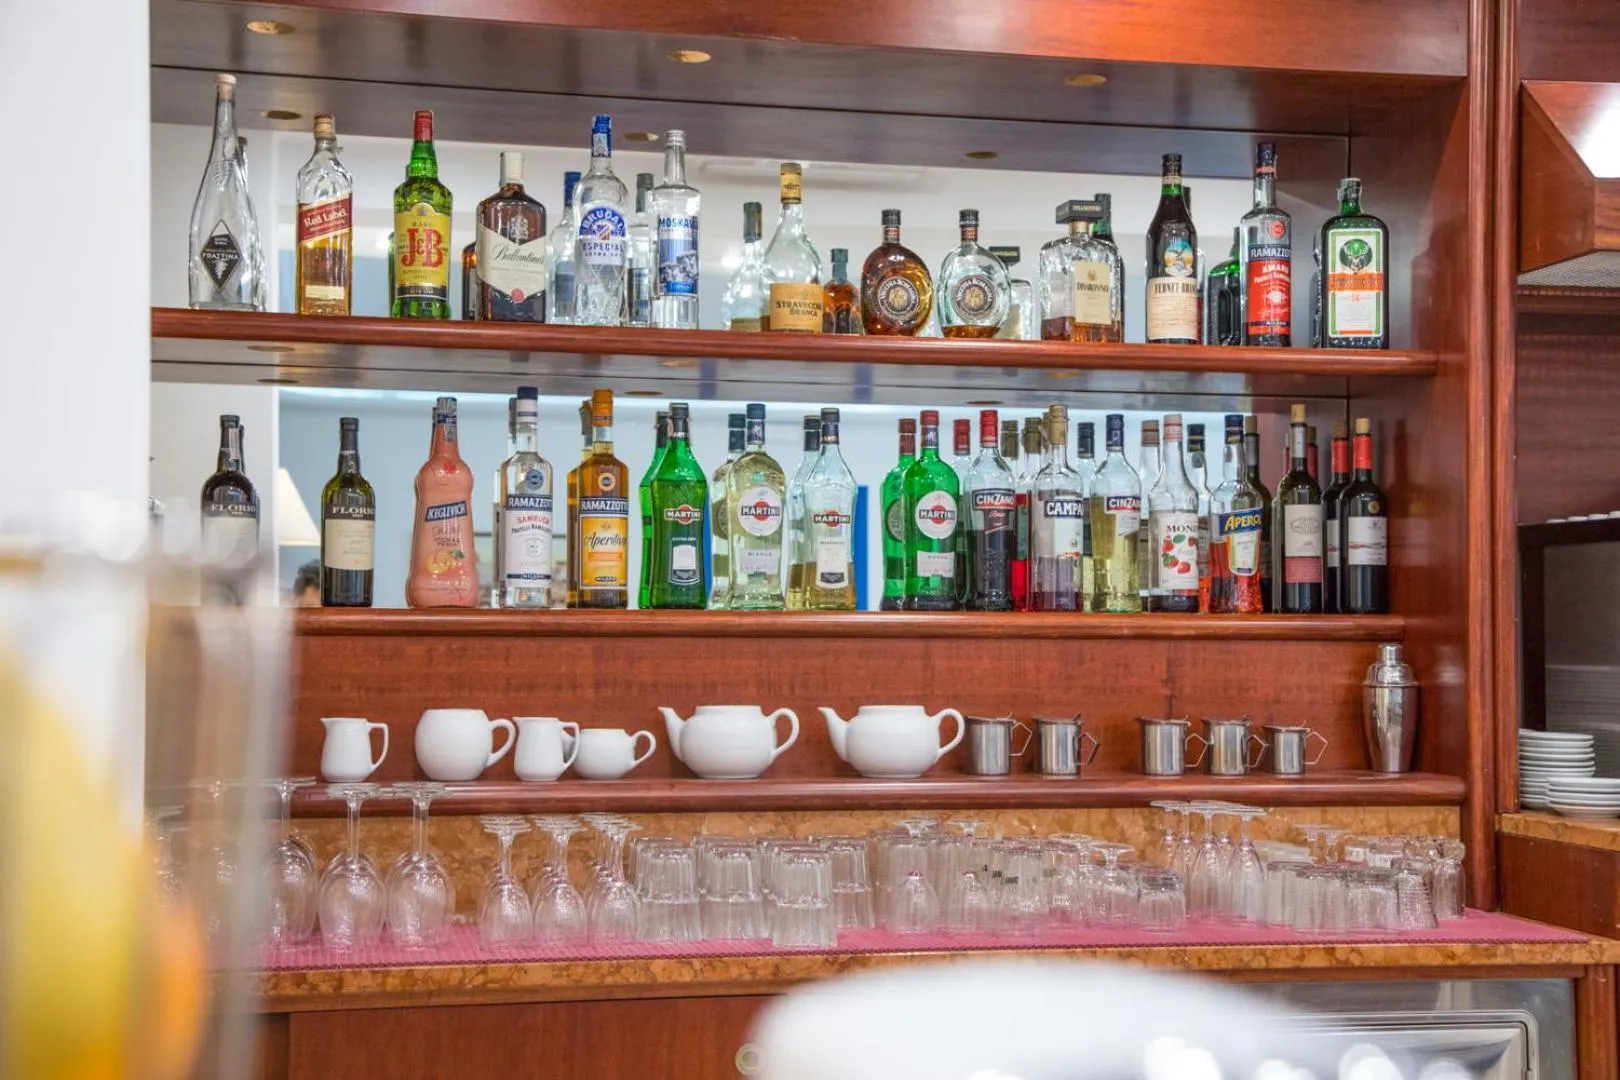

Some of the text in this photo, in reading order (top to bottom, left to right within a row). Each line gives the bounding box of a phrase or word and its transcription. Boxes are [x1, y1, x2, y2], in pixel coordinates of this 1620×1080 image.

[303, 207, 347, 228] Red Label
[581, 209, 624, 231] BRUGAL
[202, 251, 239, 261] FRATTINA
[427, 503, 466, 520] KEGLEVICH
[667, 510, 701, 519] MARTINI
[814, 515, 849, 523] MARTINI
